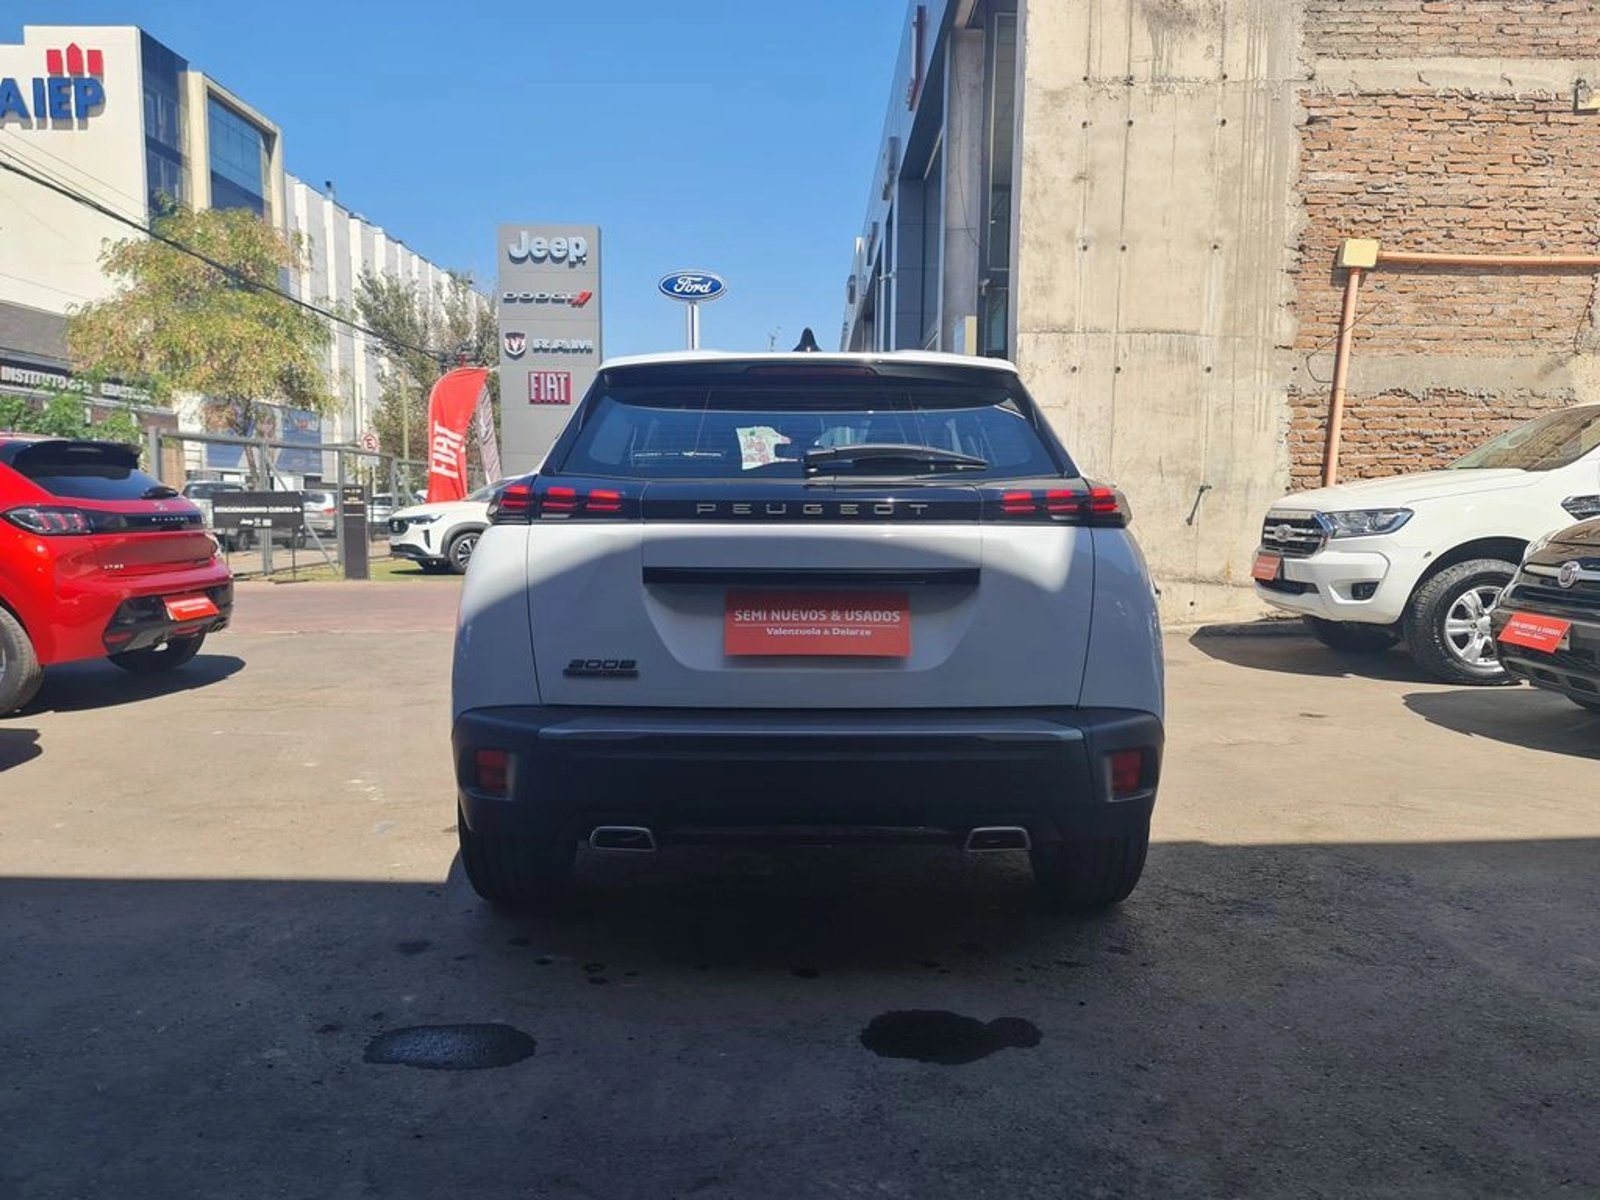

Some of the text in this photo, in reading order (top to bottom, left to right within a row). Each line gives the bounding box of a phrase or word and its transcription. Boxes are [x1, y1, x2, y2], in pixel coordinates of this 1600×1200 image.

[0, 78, 106, 119] AIEP
[508, 231, 588, 263] Jeep
[674, 276, 712, 294] Ford
[533, 338, 593, 353] RAM
[530, 372, 568, 401] FIAT
[430, 420, 464, 479] FIAT
[696, 503, 929, 515] PEUGEOT
[734, 610, 900, 622] SEMI NUEVOS & USADOS
